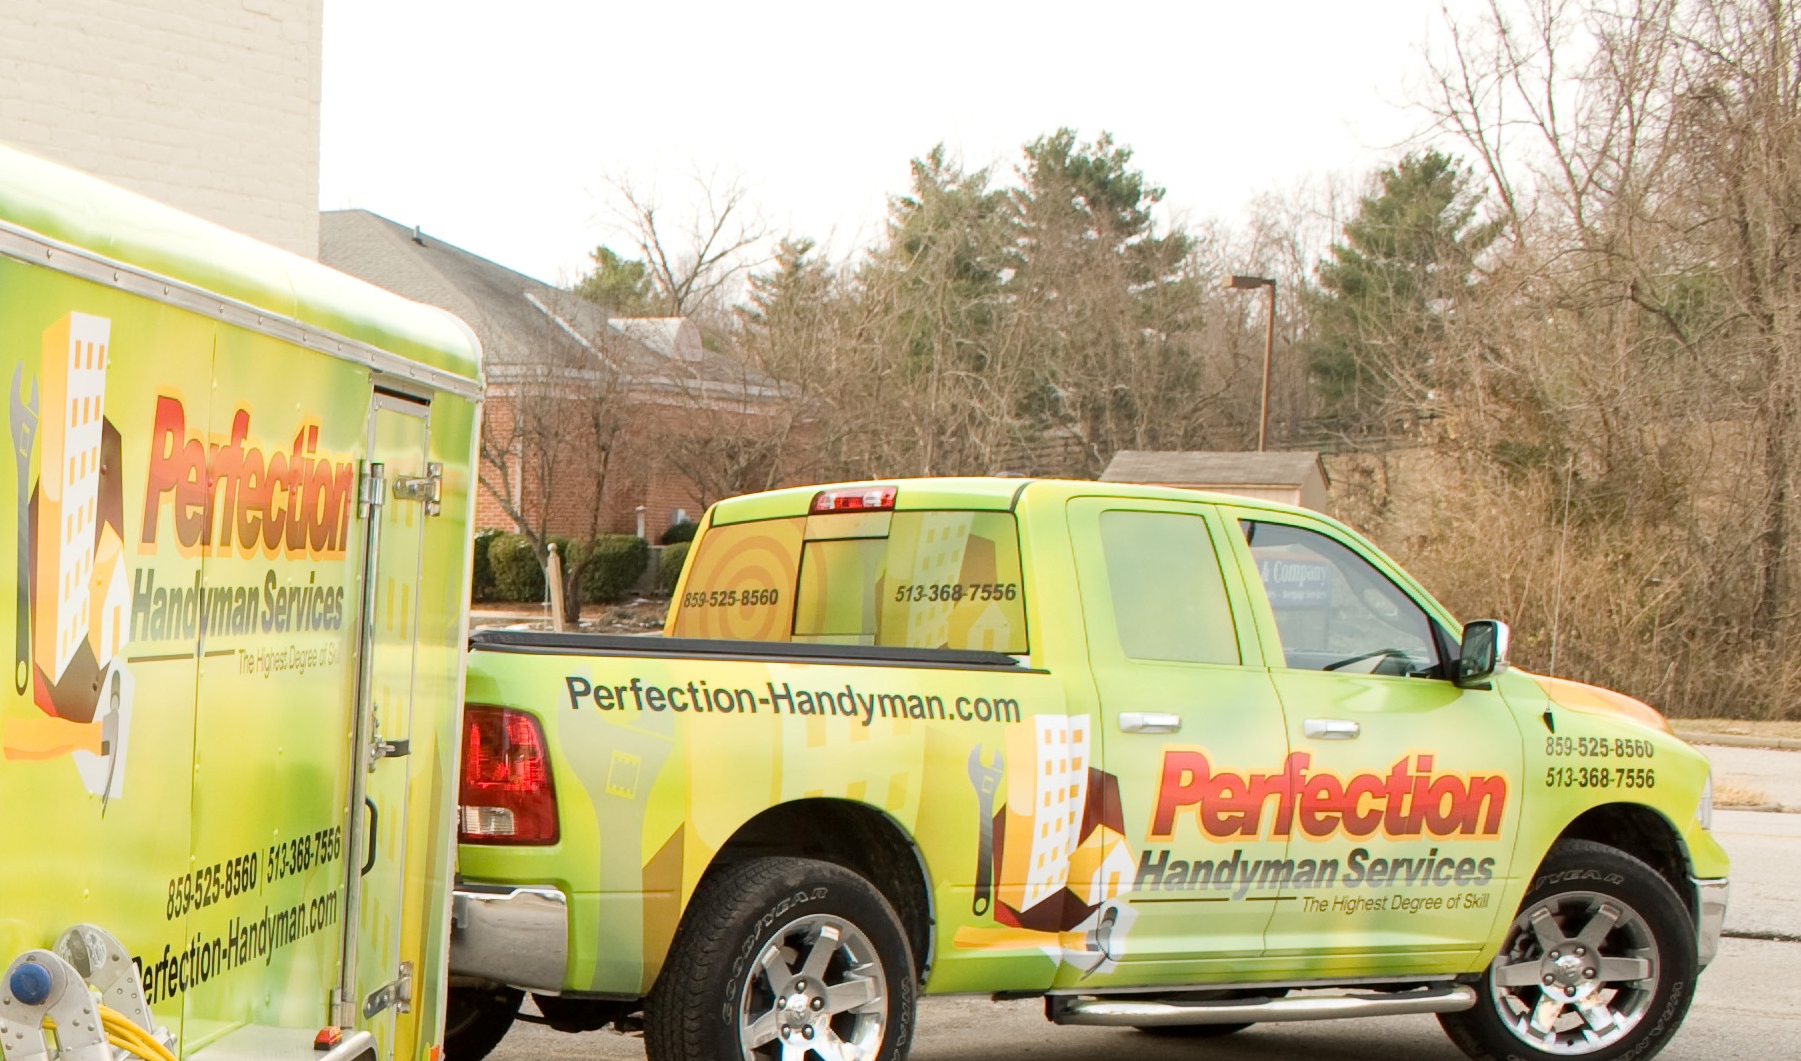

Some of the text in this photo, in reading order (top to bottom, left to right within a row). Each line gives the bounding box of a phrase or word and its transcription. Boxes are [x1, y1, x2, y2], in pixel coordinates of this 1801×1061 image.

[141, 393, 354, 553] Perfection
[895, 583, 1017, 602] 513-368-7556
[1273, 560, 1328, 588] Company
[129, 568, 344, 656] Handyman Services
[683, 588, 779, 608] 859-525-8560
[239, 648, 254, 675] The
[256, 646, 287, 679] Highest
[289, 644, 318, 675] Degree
[566, 676, 1022, 726] Perfection-Handyman.com
[1545, 736, 1654, 758] 859-525-8560
[1151, 751, 1507, 837] Perfection
[1545, 767, 1655, 788] 513-368-7556
[167, 852, 257, 921] 859-525-8560
[267, 825, 341, 883] 513-368-7556
[1132, 848, 1496, 899] Handyman Services
[1303, 893, 1490, 915] The Highest Degree of Skill
[722, 887, 828, 1025] GOODYEAR
